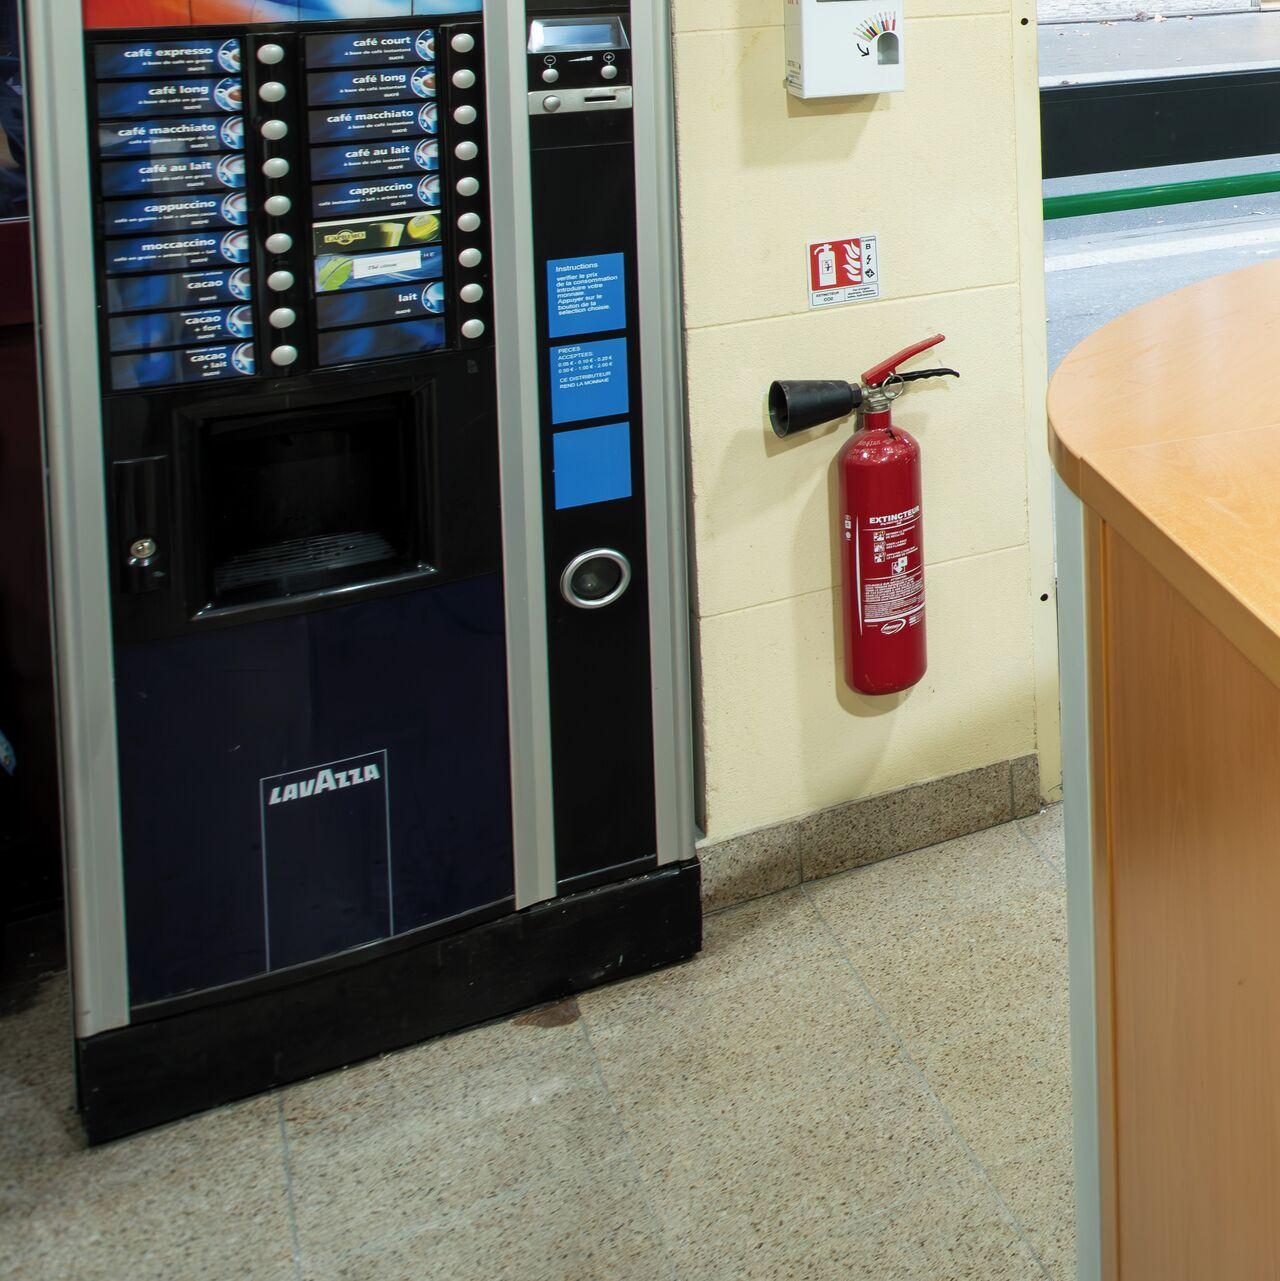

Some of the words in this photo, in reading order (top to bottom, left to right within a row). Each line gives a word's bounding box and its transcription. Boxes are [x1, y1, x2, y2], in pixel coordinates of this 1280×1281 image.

[353, 37, 378, 47] café
[381, 36, 411, 45] court
[124, 47, 152, 58] café
[155, 47, 214, 58] expresso
[352, 75, 377, 84] café
[380, 74, 406, 83] long
[149, 86, 176, 96] café
[180, 85, 209, 96] long
[327, 114, 352, 123] café
[355, 109, 414, 121] macchiato
[118, 127, 146, 137] café
[150, 123, 216, 135] macchiato
[345, 148, 370, 158] café
[373, 148, 388, 156] au
[391, 145, 410, 155] lait
[139, 165, 167, 174] café
[170, 164, 187, 172] au
[190, 161, 212, 171] lait
[349, 182, 413, 196] cappuccino
[144, 200, 216, 213] cappuccino
[142, 238, 216, 251] moccaccino
[556, 262, 598, 272] Instructions
[187, 280, 223, 290] cacao
[398, 293, 418, 303] lait
[185, 315, 221, 325] cacao
[190, 352, 226, 363] cacao
[210, 360, 227, 368] lait
[269, 764, 381, 805] LAVAZZA
